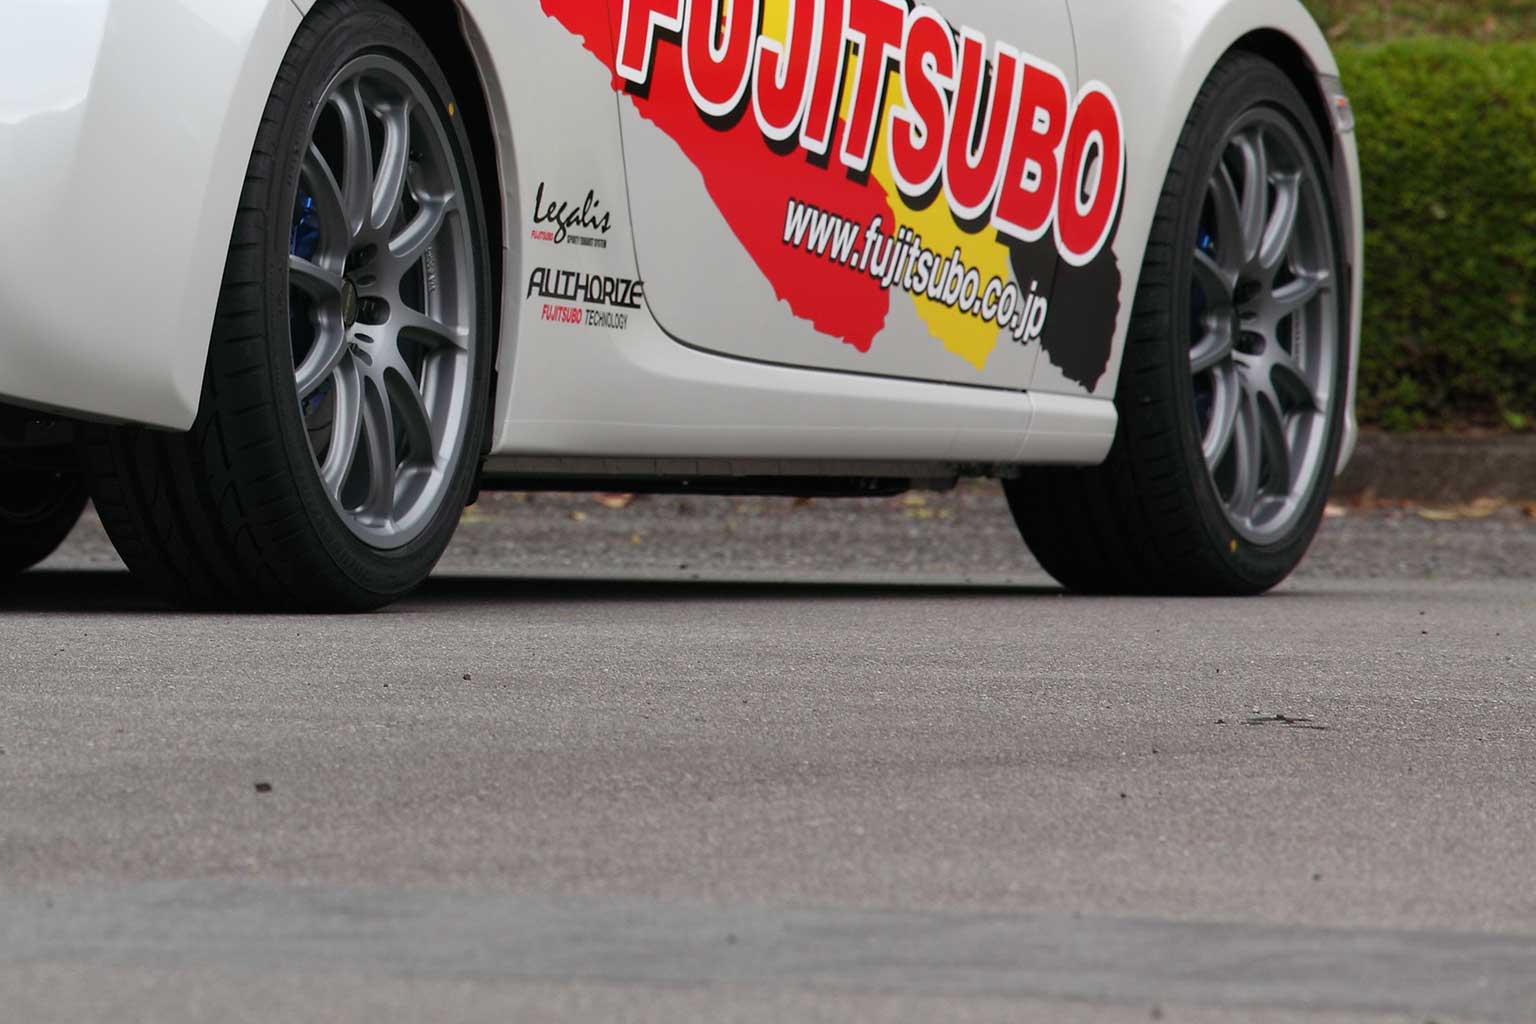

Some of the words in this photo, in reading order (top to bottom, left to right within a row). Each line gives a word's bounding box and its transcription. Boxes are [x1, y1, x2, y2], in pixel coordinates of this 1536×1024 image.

[533, 181, 611, 244] Legalis
[527, 266, 644, 309] AUTHORIZE
[782, 198, 1048, 343] www.fujitsubo.co.jp
[541, 304, 583, 324] FUJITSUBO
[585, 309, 629, 330] TECHNOLOGY
